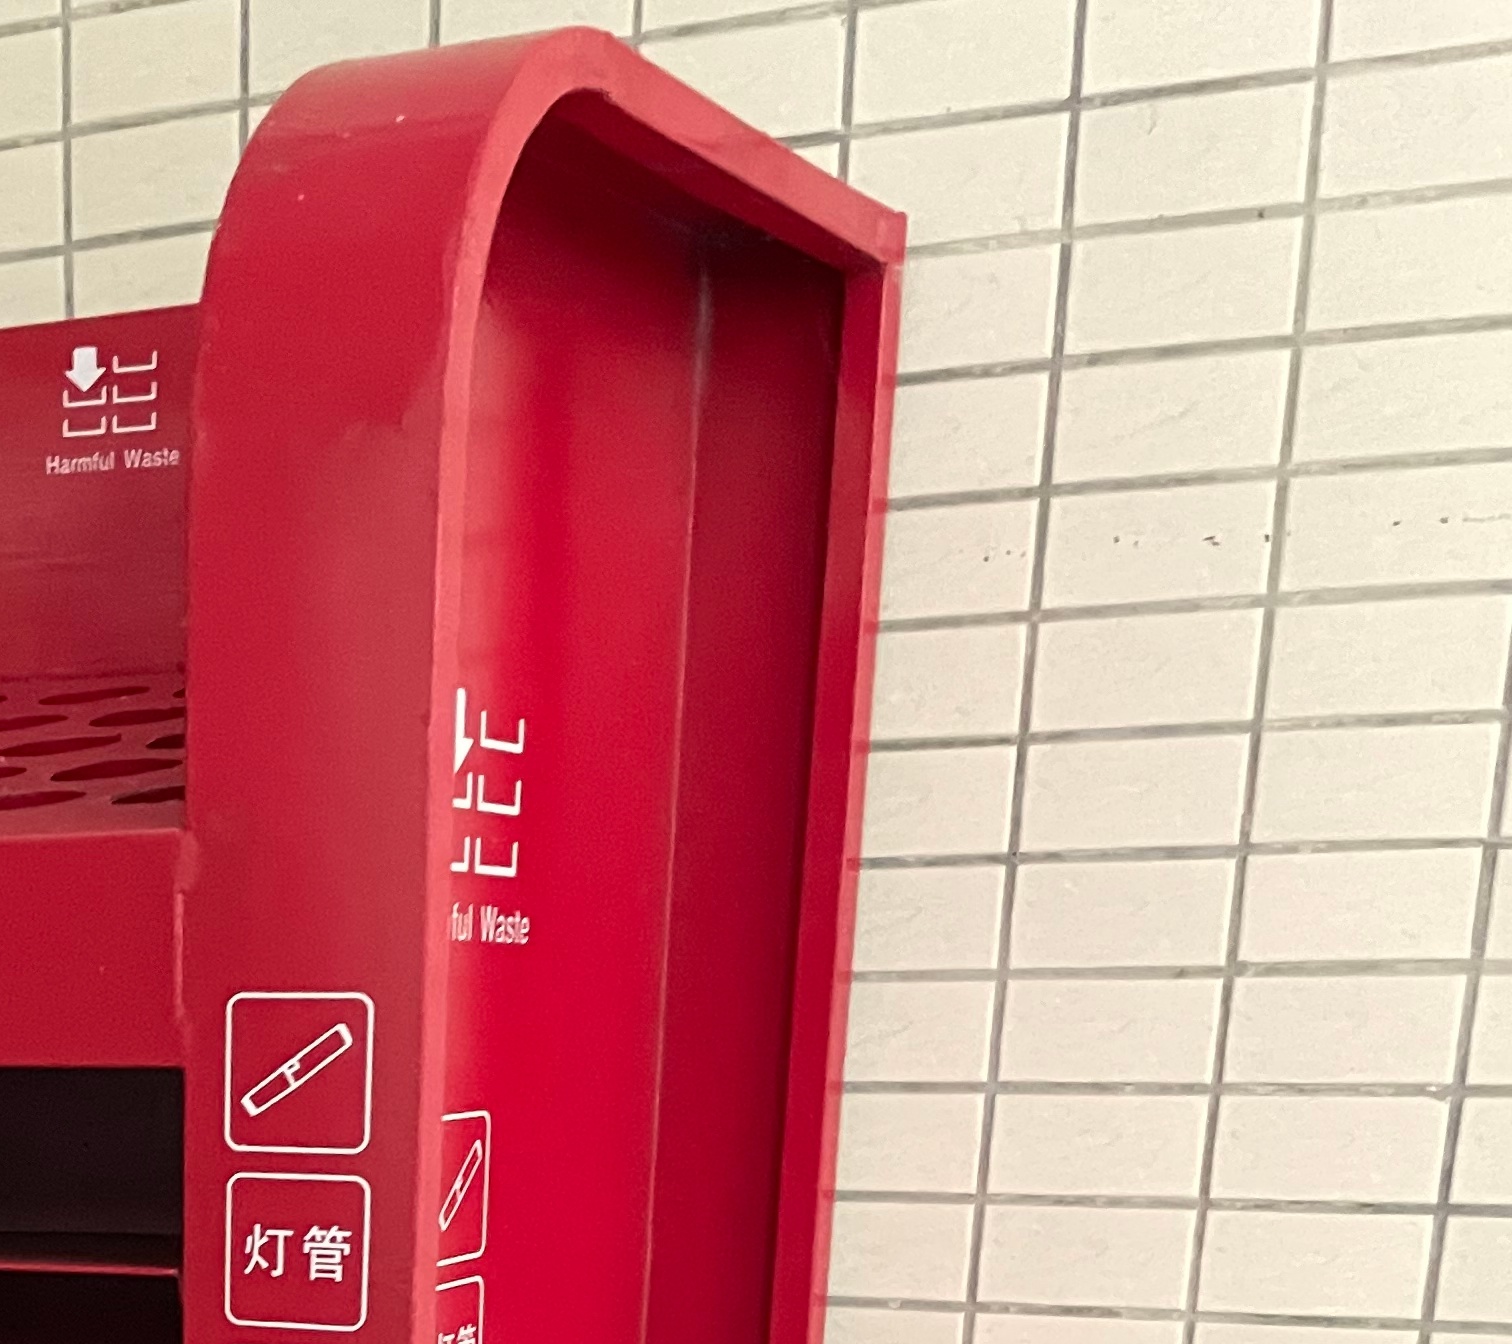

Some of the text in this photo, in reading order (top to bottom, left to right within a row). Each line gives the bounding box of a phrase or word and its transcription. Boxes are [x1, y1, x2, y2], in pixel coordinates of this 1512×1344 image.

[45, 448, 180, 475] Harmful Waste
[480, 904, 530, 945] Waste
[243, 1223, 353, 1283] 灯管
